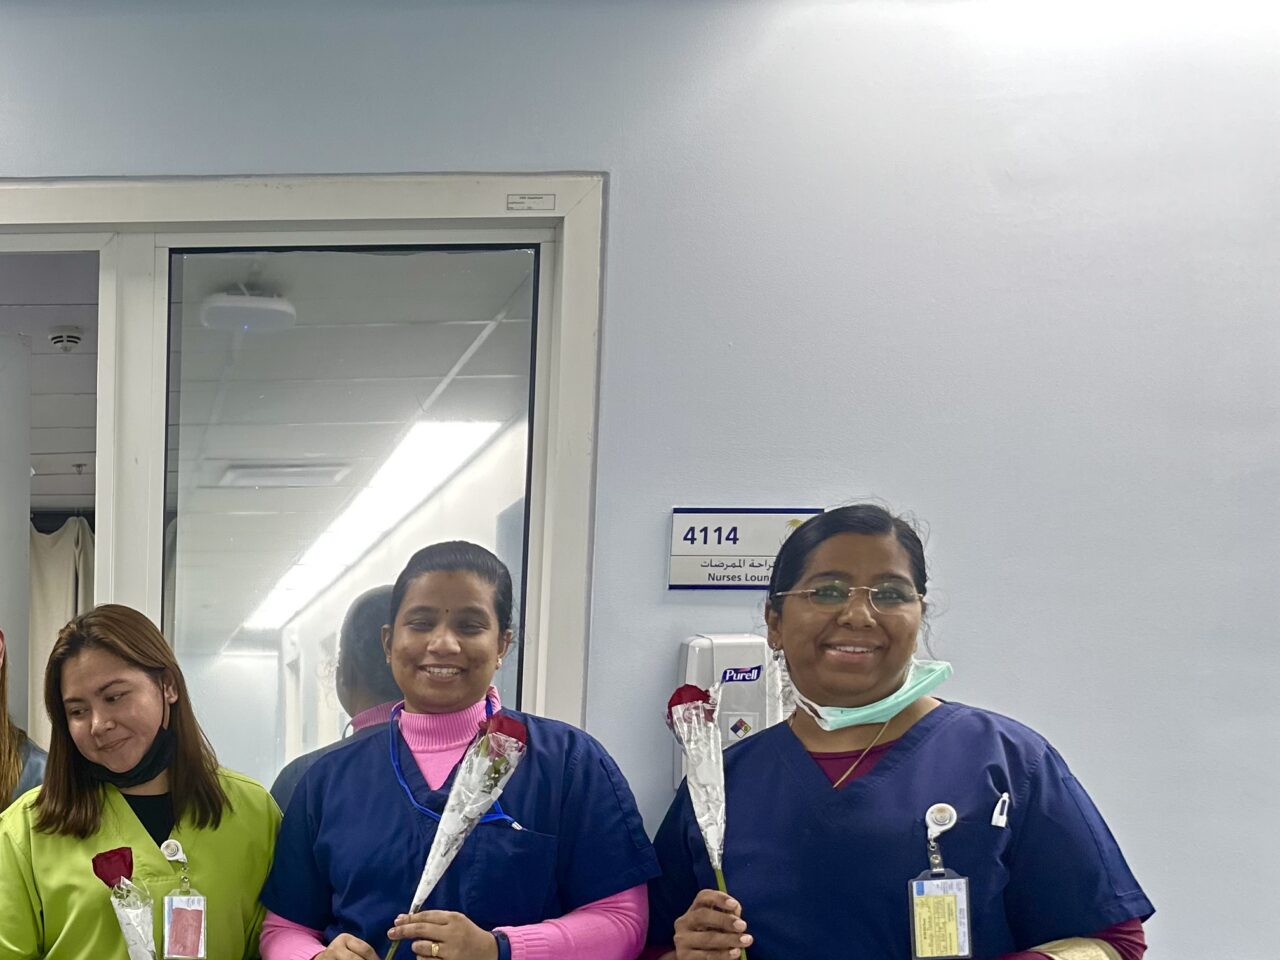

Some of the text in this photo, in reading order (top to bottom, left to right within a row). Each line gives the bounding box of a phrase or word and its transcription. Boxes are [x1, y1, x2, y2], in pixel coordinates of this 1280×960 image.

[683, 526, 739, 545] 4114
[707, 573, 770, 582] Nurses Loun
[725, 669, 758, 681] Purell
